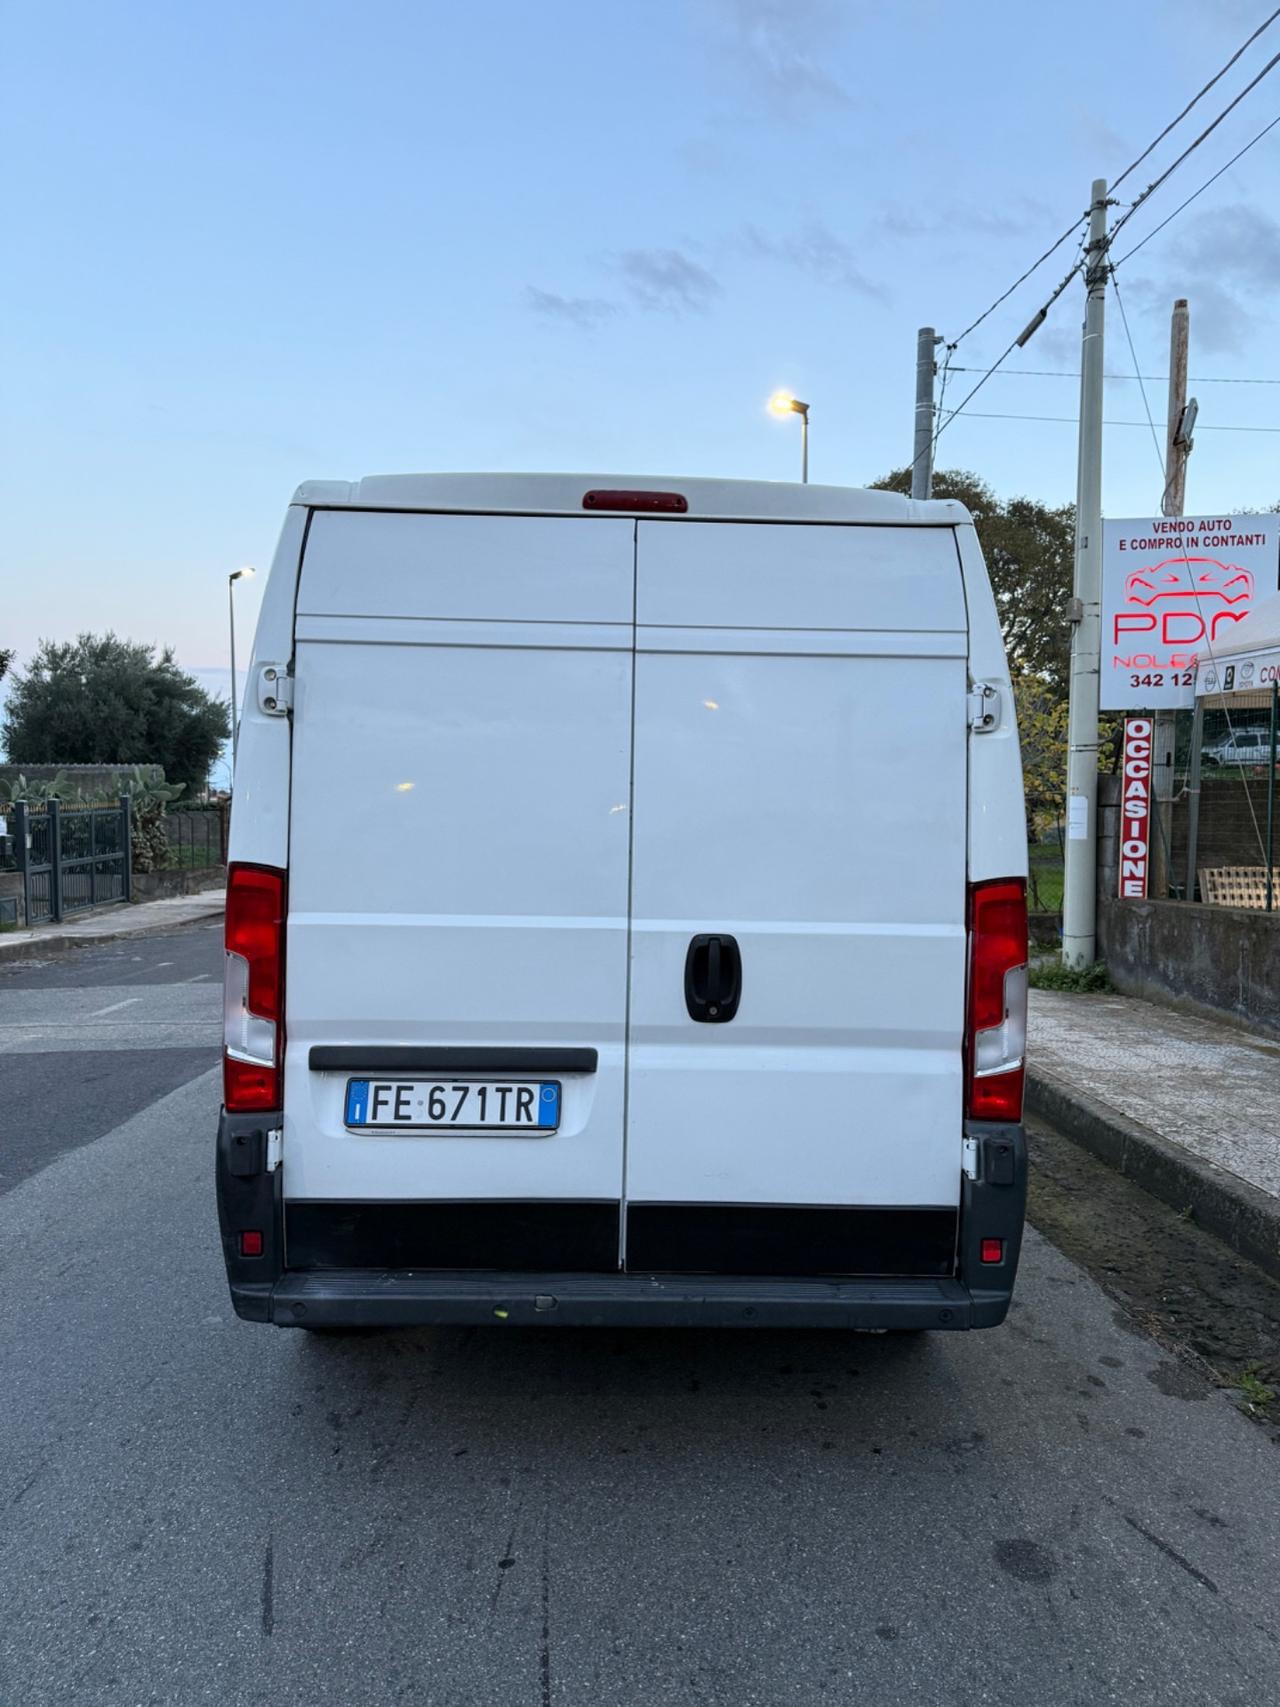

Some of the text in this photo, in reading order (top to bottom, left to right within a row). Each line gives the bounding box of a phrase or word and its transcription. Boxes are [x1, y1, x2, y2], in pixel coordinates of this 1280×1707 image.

[1152, 519, 1232, 534] VENDO AUTO
[1119, 533, 1266, 551] E COMPRO IN CONTANTI
[1130, 673, 1164, 688] 342
[1171, 672, 1193, 687] 12
[1123, 719, 1151, 897] OCCASIONE
